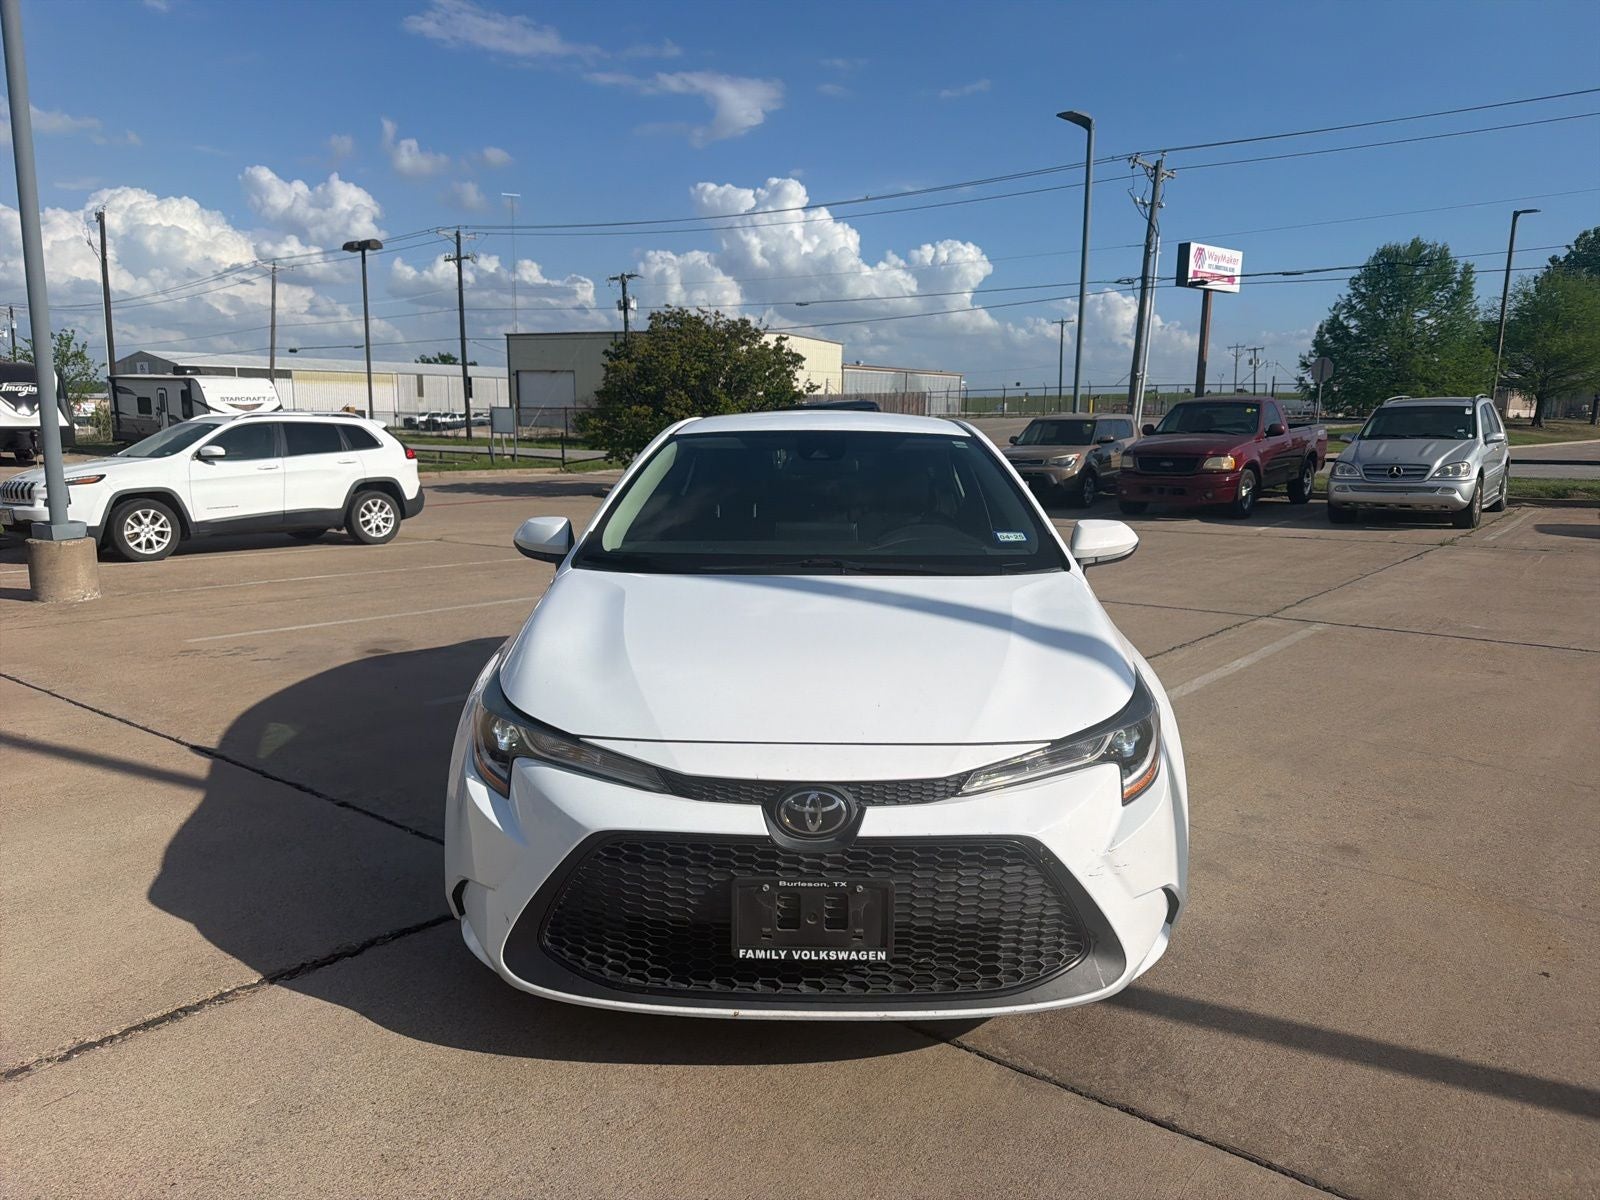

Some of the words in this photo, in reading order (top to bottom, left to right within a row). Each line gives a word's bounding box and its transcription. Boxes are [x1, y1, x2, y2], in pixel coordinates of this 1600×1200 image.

[1207, 250, 1240, 265] WayMaker
[1, 382, 38, 396] Imagin
[778, 880, 830, 888] Burleson,
[739, 949, 788, 960] FAMILY
[793, 950, 887, 961] VOLKSWAGEN
